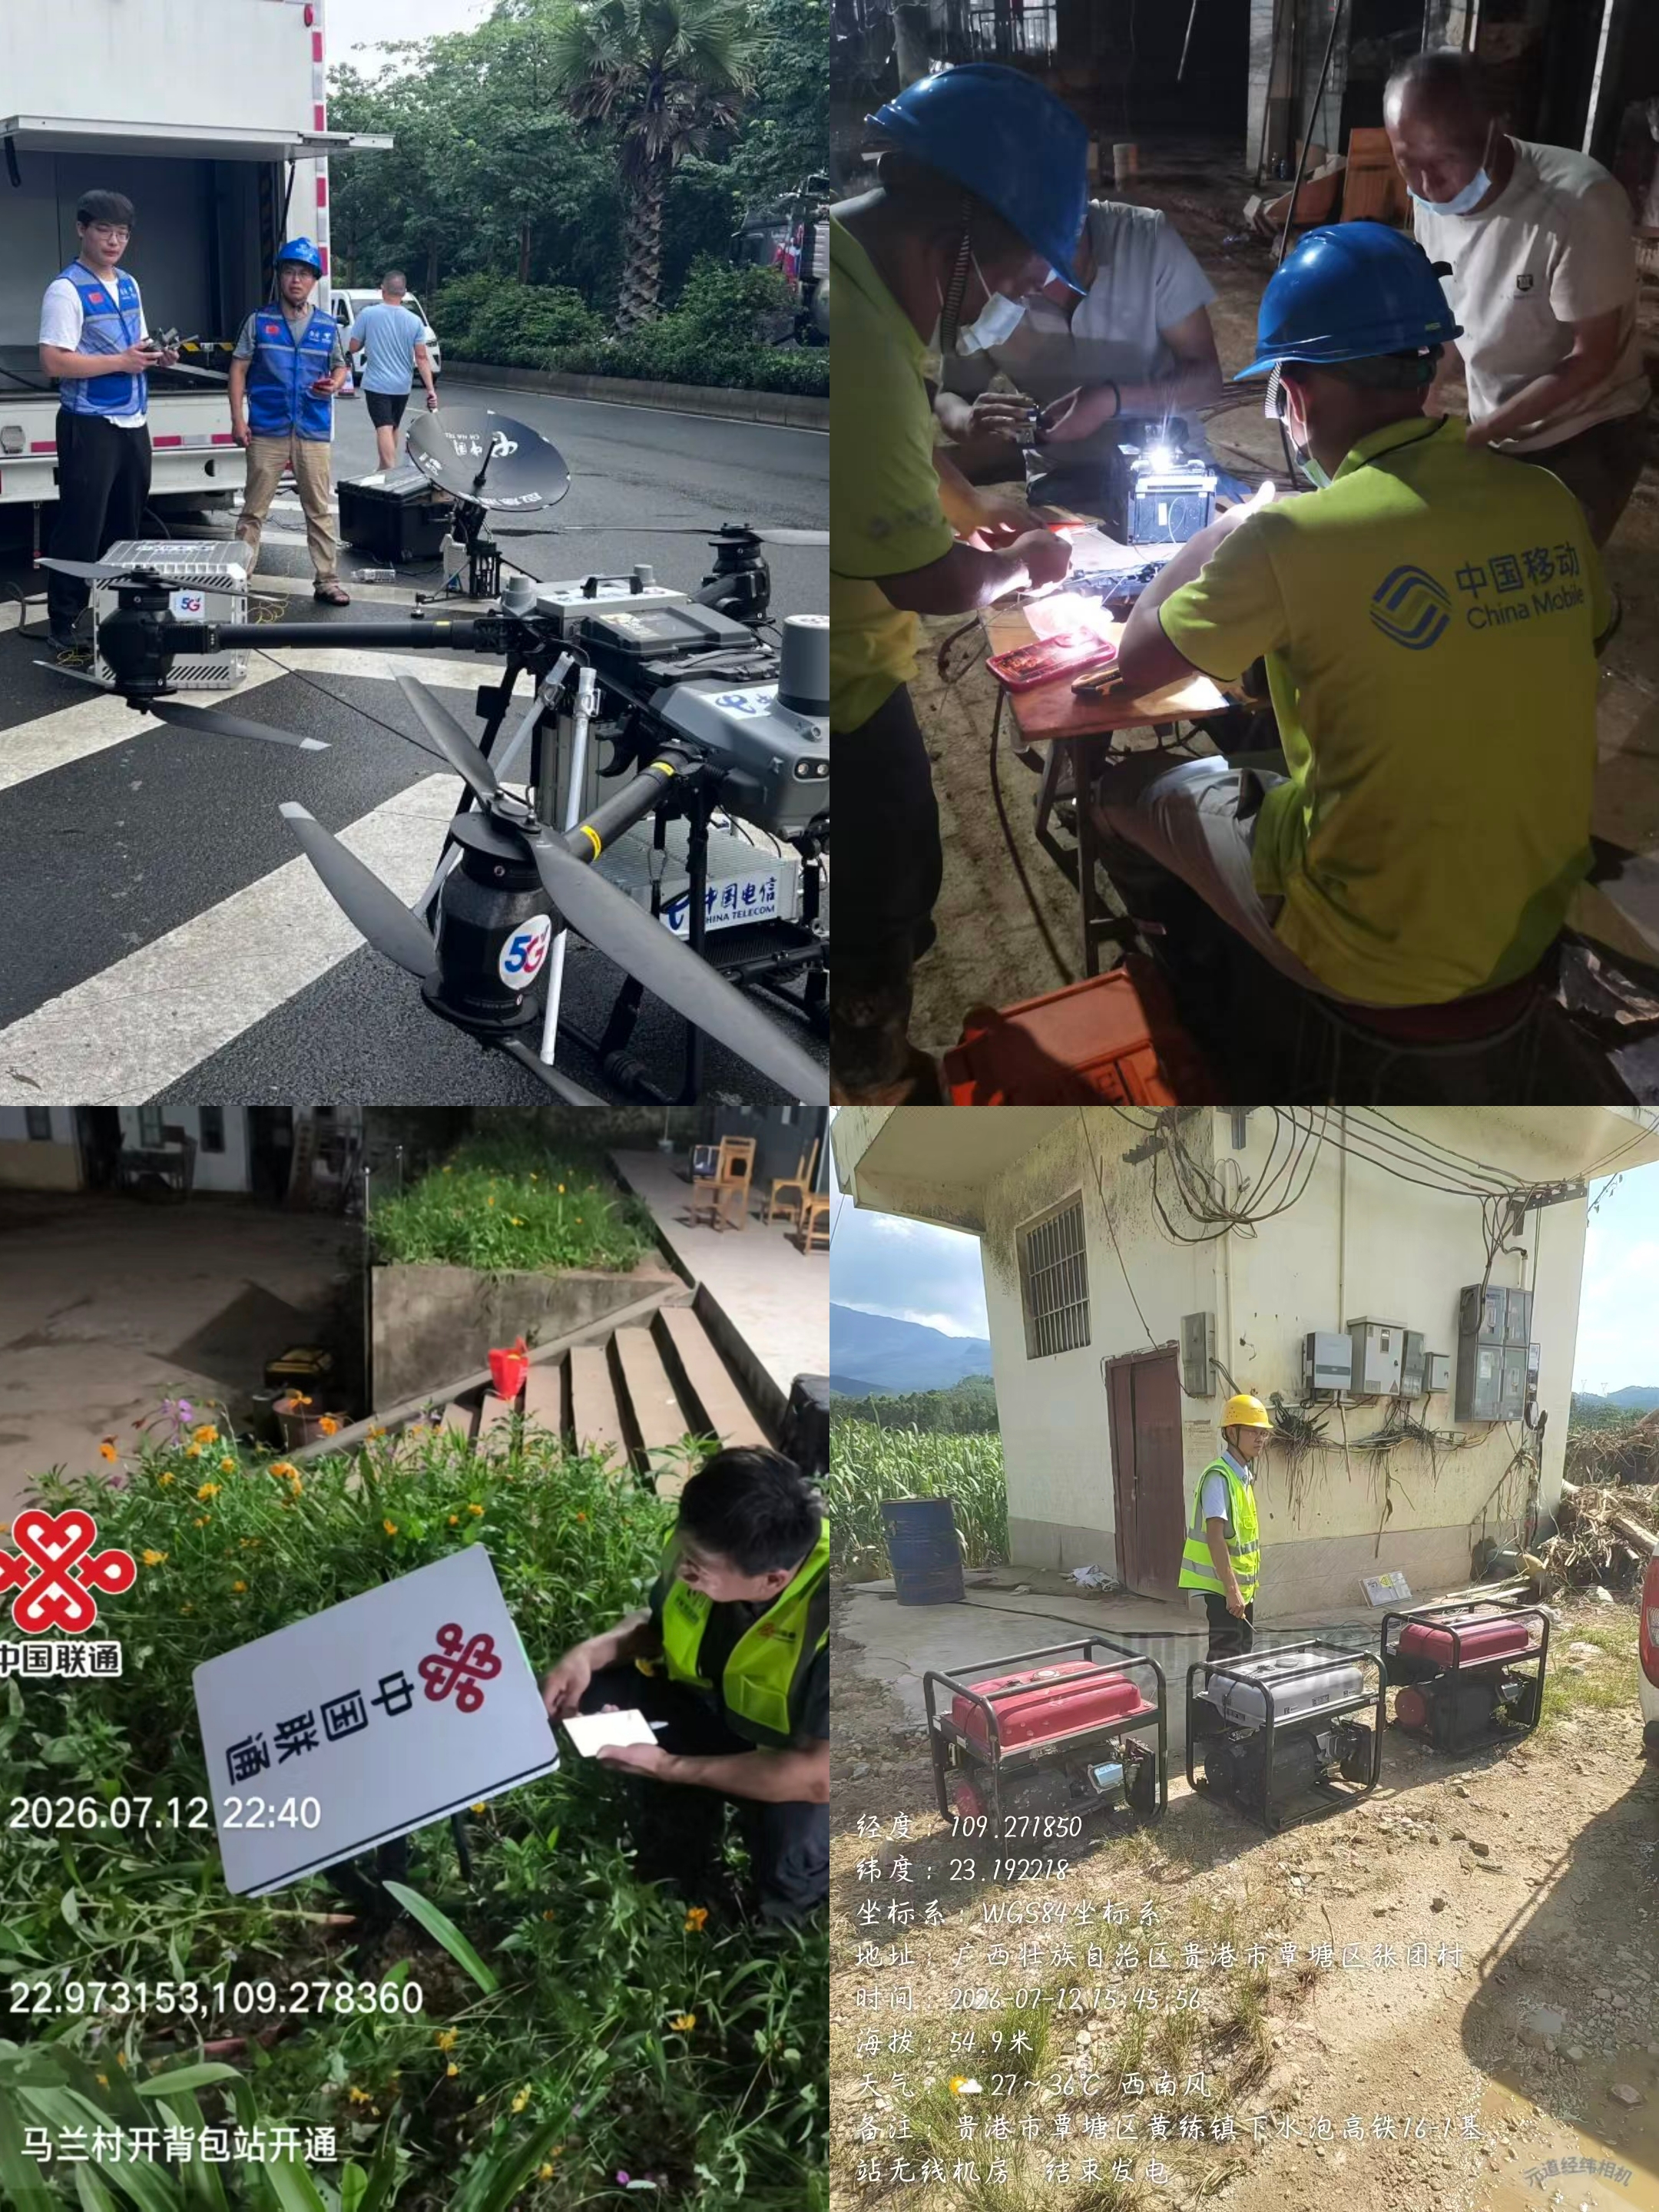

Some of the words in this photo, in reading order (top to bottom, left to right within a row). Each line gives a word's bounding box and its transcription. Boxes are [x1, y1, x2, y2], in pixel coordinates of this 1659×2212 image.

[1455, 540, 1580, 599] 中国移动
[181, 597, 200, 611] 5G
[1466, 602, 1531, 630] China
[1532, 584, 1584, 616] Mobile
[705, 913, 730, 924] HINA
[733, 905, 775, 919] TELECOM
[505, 934, 545, 973] 5G
[226, 1670, 415, 1786] 中国联通
